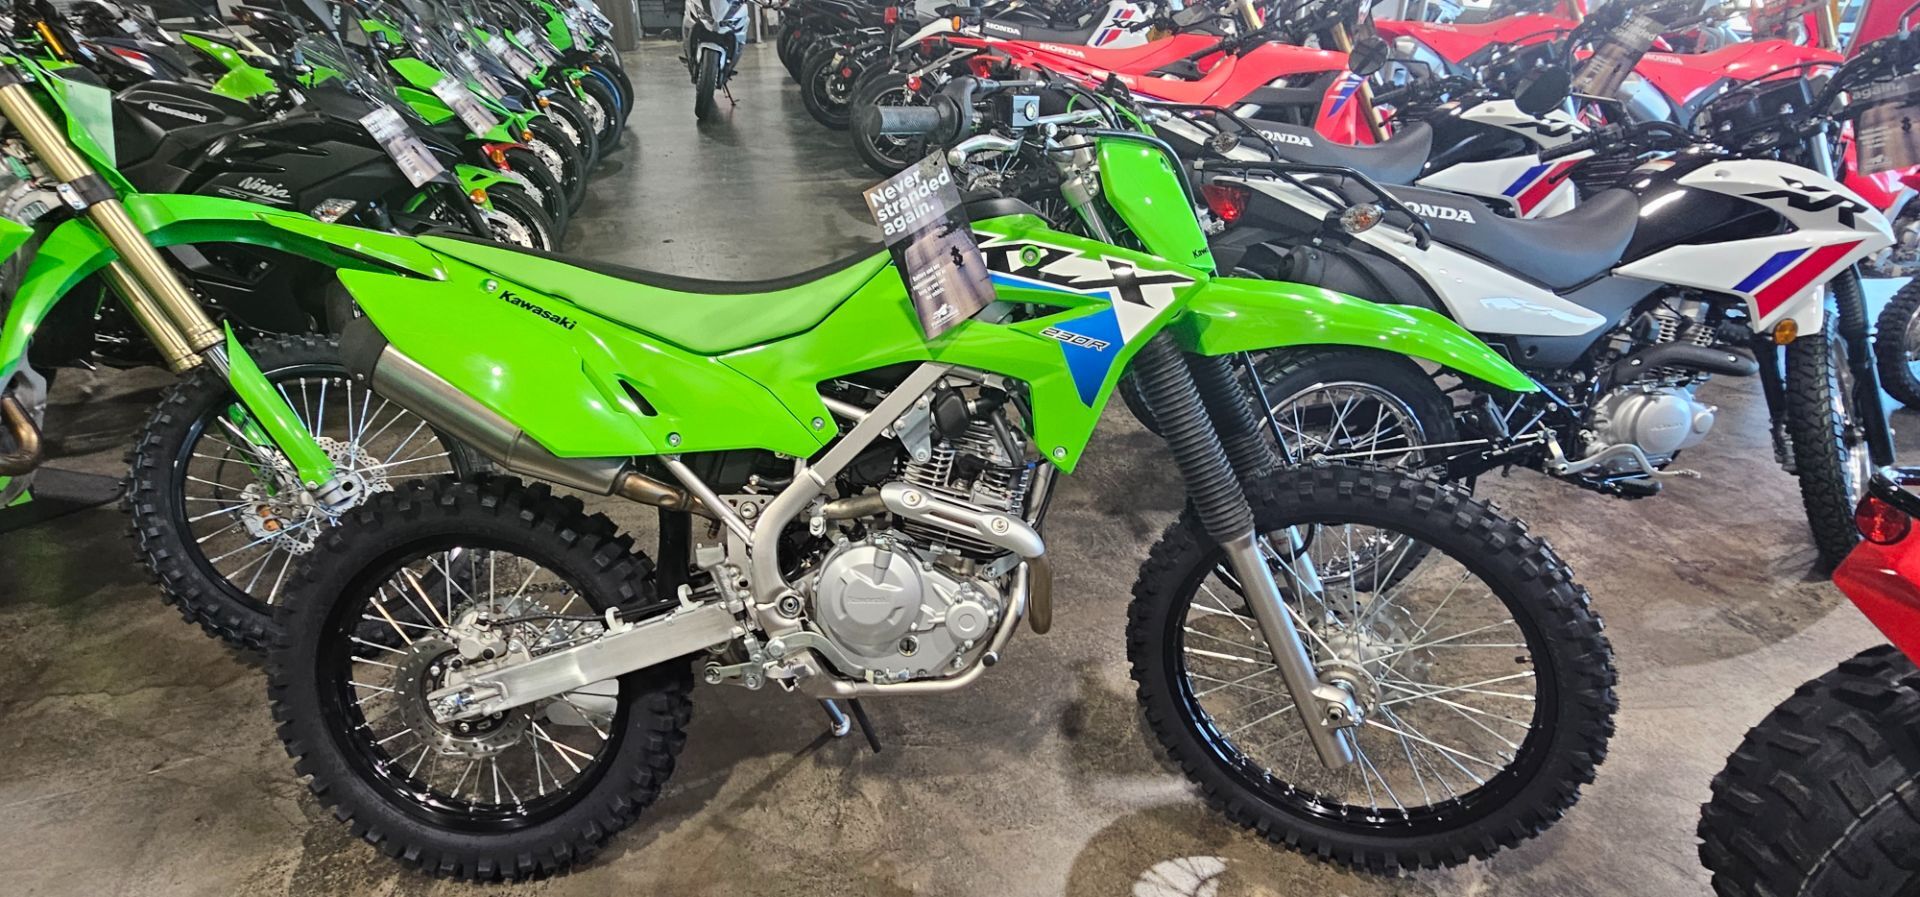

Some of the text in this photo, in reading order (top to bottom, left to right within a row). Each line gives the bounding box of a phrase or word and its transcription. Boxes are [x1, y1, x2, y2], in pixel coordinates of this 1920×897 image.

[985, 22, 1021, 35] HONDA
[1039, 42, 1086, 58] HONDA
[1644, 51, 1684, 65] HONDA
[148, 102, 207, 123] Kawasaki
[1257, 129, 1314, 148] ONDA
[238, 176, 291, 199] Ninja
[870, 170, 920, 207] Never
[877, 168, 950, 221] stranded
[883, 201, 934, 236] again.
[1404, 201, 1476, 224] ONDA
[498, 290, 577, 330] Kawasaki
[1039, 326, 1111, 352] 230R
